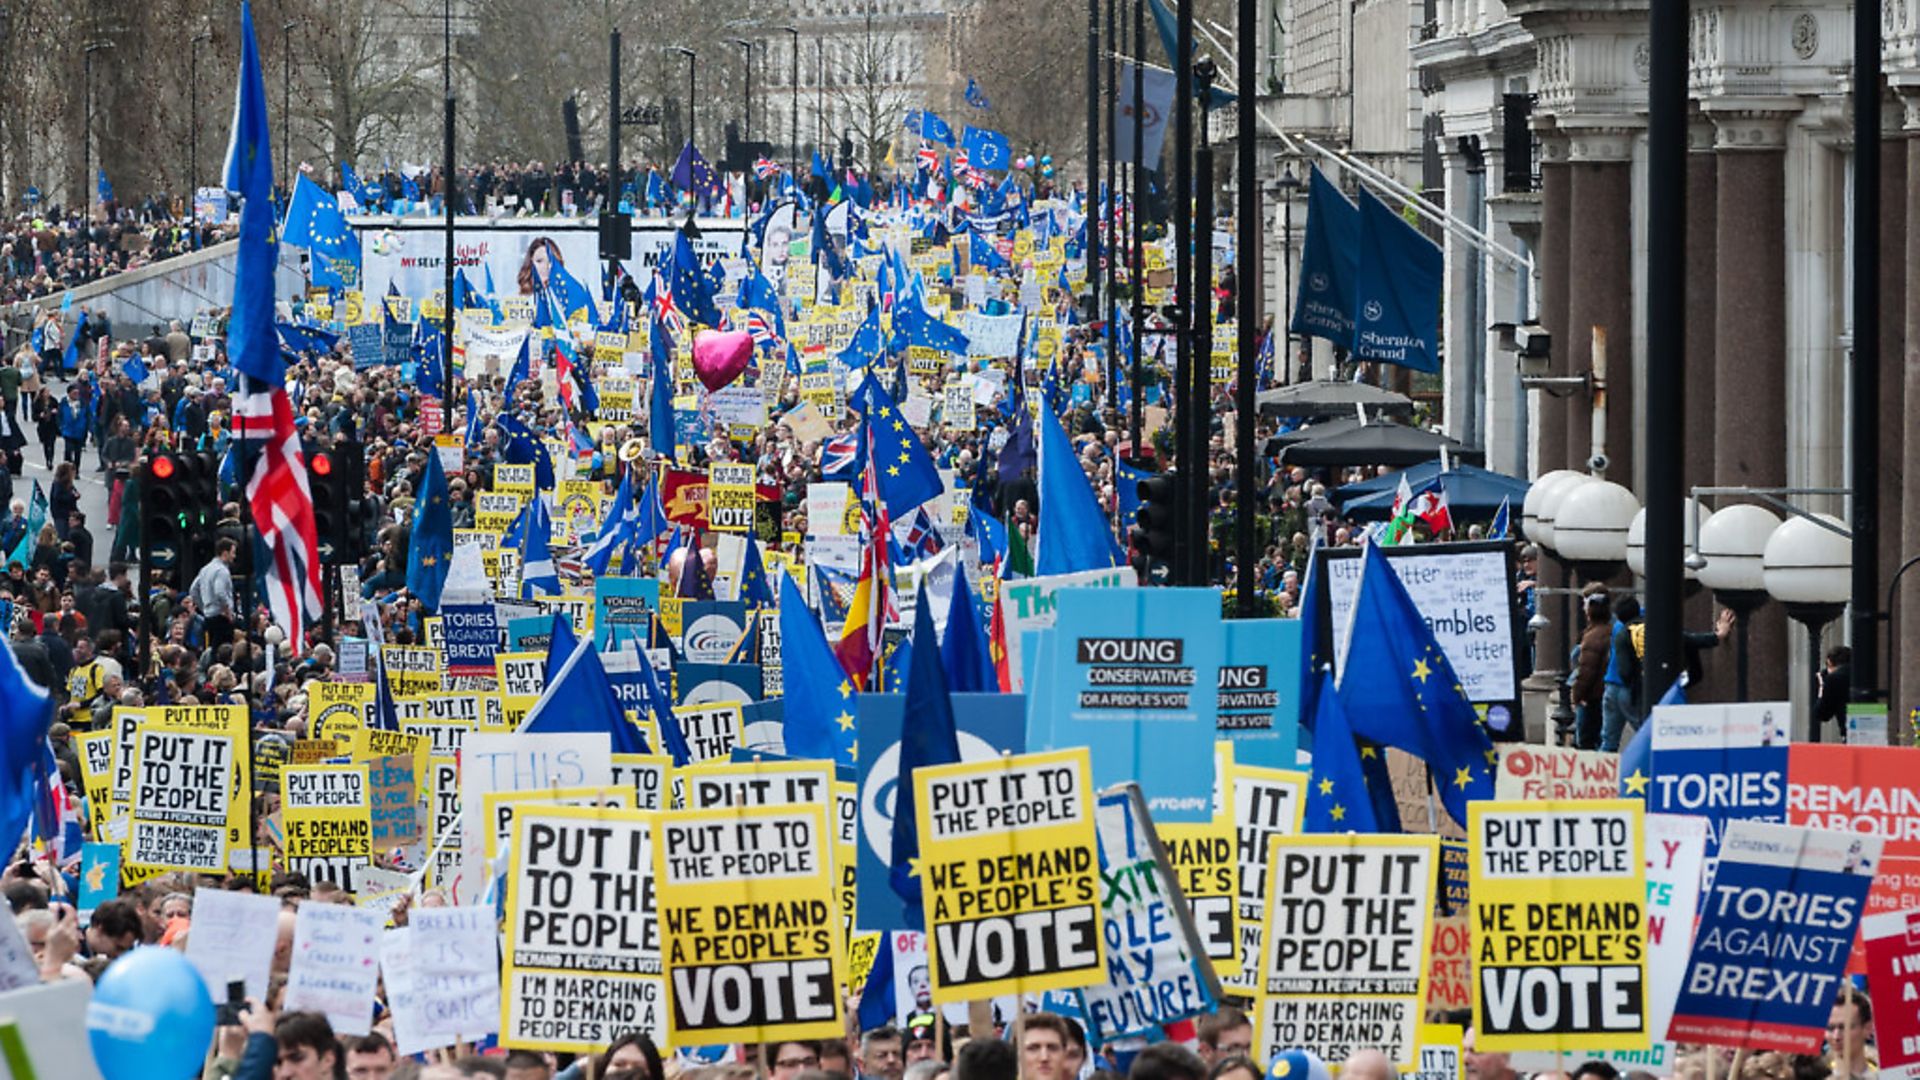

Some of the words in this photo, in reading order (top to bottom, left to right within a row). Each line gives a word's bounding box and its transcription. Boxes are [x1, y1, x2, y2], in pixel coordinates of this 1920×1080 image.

[1359, 344, 1406, 361] Grand
[1360, 331, 1426, 350] Sheraton
[602, 408, 631, 420] VOTE
[712, 509, 753, 525] VOTE
[445, 613, 495, 627] TORIES
[447, 629, 496, 641] AGAINST
[449, 644, 498, 658] BREXIT
[1084, 640, 1176, 663] YOUNG
[505, 663, 535, 679] PUT
[1087, 668, 1197, 685] CONSERVATIVES
[507, 680, 531, 694] THE
[1111, 693, 1160, 706] PEOPLE'S
[1161, 694, 1190, 706] VOTE
[165, 708, 190, 721] PUT
[196, 708, 207, 721] IT
[214, 708, 230, 721] TO
[460, 698, 475, 715] IT
[712, 712, 733, 736] IT
[144, 736, 194, 761] PUT
[202, 739, 227, 765] IT
[143, 761, 171, 786] TO
[180, 765, 225, 790] THE
[476, 750, 585, 791] THIS
[631, 768, 658, 790] TO
[1506, 751, 1578, 780] ONLY
[1581, 758, 1618, 782] WAY
[288, 774, 318, 790] PUT
[323, 774, 338, 789] IT
[342, 773, 361, 789] TO
[784, 778, 819, 804] IT
[932, 776, 986, 811] PUT
[1001, 773, 1028, 804] IT
[1038, 769, 1074, 799] TO
[1656, 771, 1781, 809] TORIES
[140, 786, 223, 812] PEOPLE
[290, 792, 311, 805] THE
[316, 791, 361, 805] PEOPLE
[1249, 786, 1288, 827] IT
[1786, 784, 1920, 814] REMAIN
[286, 821, 306, 837] WE
[310, 820, 368, 837] DEMAND
[934, 807, 978, 834] THE
[988, 798, 1076, 828] PEOPLE
[139, 825, 154, 837] I'M
[157, 826, 218, 841] MARCHING
[667, 823, 724, 854] PUT
[736, 822, 765, 852] IT
[774, 821, 809, 849] TO
[1485, 818, 1542, 848] PUT
[1553, 818, 1579, 847] IT
[1591, 817, 1626, 847] TO
[139, 838, 152, 850] TO
[157, 838, 206, 853] DEMAND
[210, 843, 218, 855] A
[288, 841, 297, 854] A
[301, 838, 369, 854] PEOPLE'S
[528, 823, 611, 868] PUT
[136, 851, 185, 865] PEOPLES
[190, 853, 216, 867] VOTE
[670, 855, 713, 879] THE
[722, 850, 812, 877] PEOPLE
[930, 863, 962, 890] WE
[978, 846, 1091, 884] DEMAND
[1485, 850, 1529, 873] THE
[1538, 849, 1627, 873] PEOPLE
[1283, 853, 1366, 895] PUT
[1380, 853, 1420, 895] IT
[526, 869, 574, 909] TO
[590, 872, 657, 913] THE
[934, 894, 950, 920] A
[958, 876, 1094, 915] PEOPLE'S
[1869, 892, 1897, 907] the
[666, 908, 705, 934] WE
[714, 900, 828, 931] DEMAND
[1281, 898, 1325, 935] TO
[1342, 898, 1415, 936] THE
[1479, 904, 1515, 932] WE
[1527, 902, 1640, 932] DEMAND
[1716, 885, 1857, 930] TORIES
[523, 911, 661, 951] PEOPLE
[670, 938, 686, 962] A
[692, 931, 830, 960] PEOPLE'S
[937, 908, 1099, 984] VOTE
[1276, 938, 1412, 972] PEOPLE
[1480, 935, 1496, 962] A
[1506, 934, 1641, 962] PEOPLE'S
[1700, 926, 1847, 965] AGAINST
[514, 951, 560, 968] DEMAND
[579, 956, 634, 973] PEOPLE'S
[1107, 947, 1154, 987] MY
[1892, 957, 1901, 977] I
[522, 976, 547, 996] I'M
[554, 978, 656, 1001] MARCHING
[671, 960, 834, 1030] VOTE
[1268, 979, 1314, 993] DEMAND
[1389, 980, 1418, 993] VOTE
[1688, 962, 1837, 1006] BREXIT
[521, 999, 546, 1018] TO
[554, 1001, 637, 1021] DEMAND
[644, 1003, 656, 1023] A
[1091, 974, 1197, 1036] FUTURE
[1274, 1001, 1298, 1021] I'M
[1305, 1002, 1404, 1021] MARCHING
[1482, 966, 1641, 1031] VOTE
[519, 1020, 602, 1040] PEOPLES
[1274, 1023, 1297, 1042] TO
[1304, 1023, 1383, 1042] DEMAND
[1391, 1023, 1402, 1042] A
[1422, 1050, 1435, 1069] IT
[1441, 1050, 1456, 1069] TO
